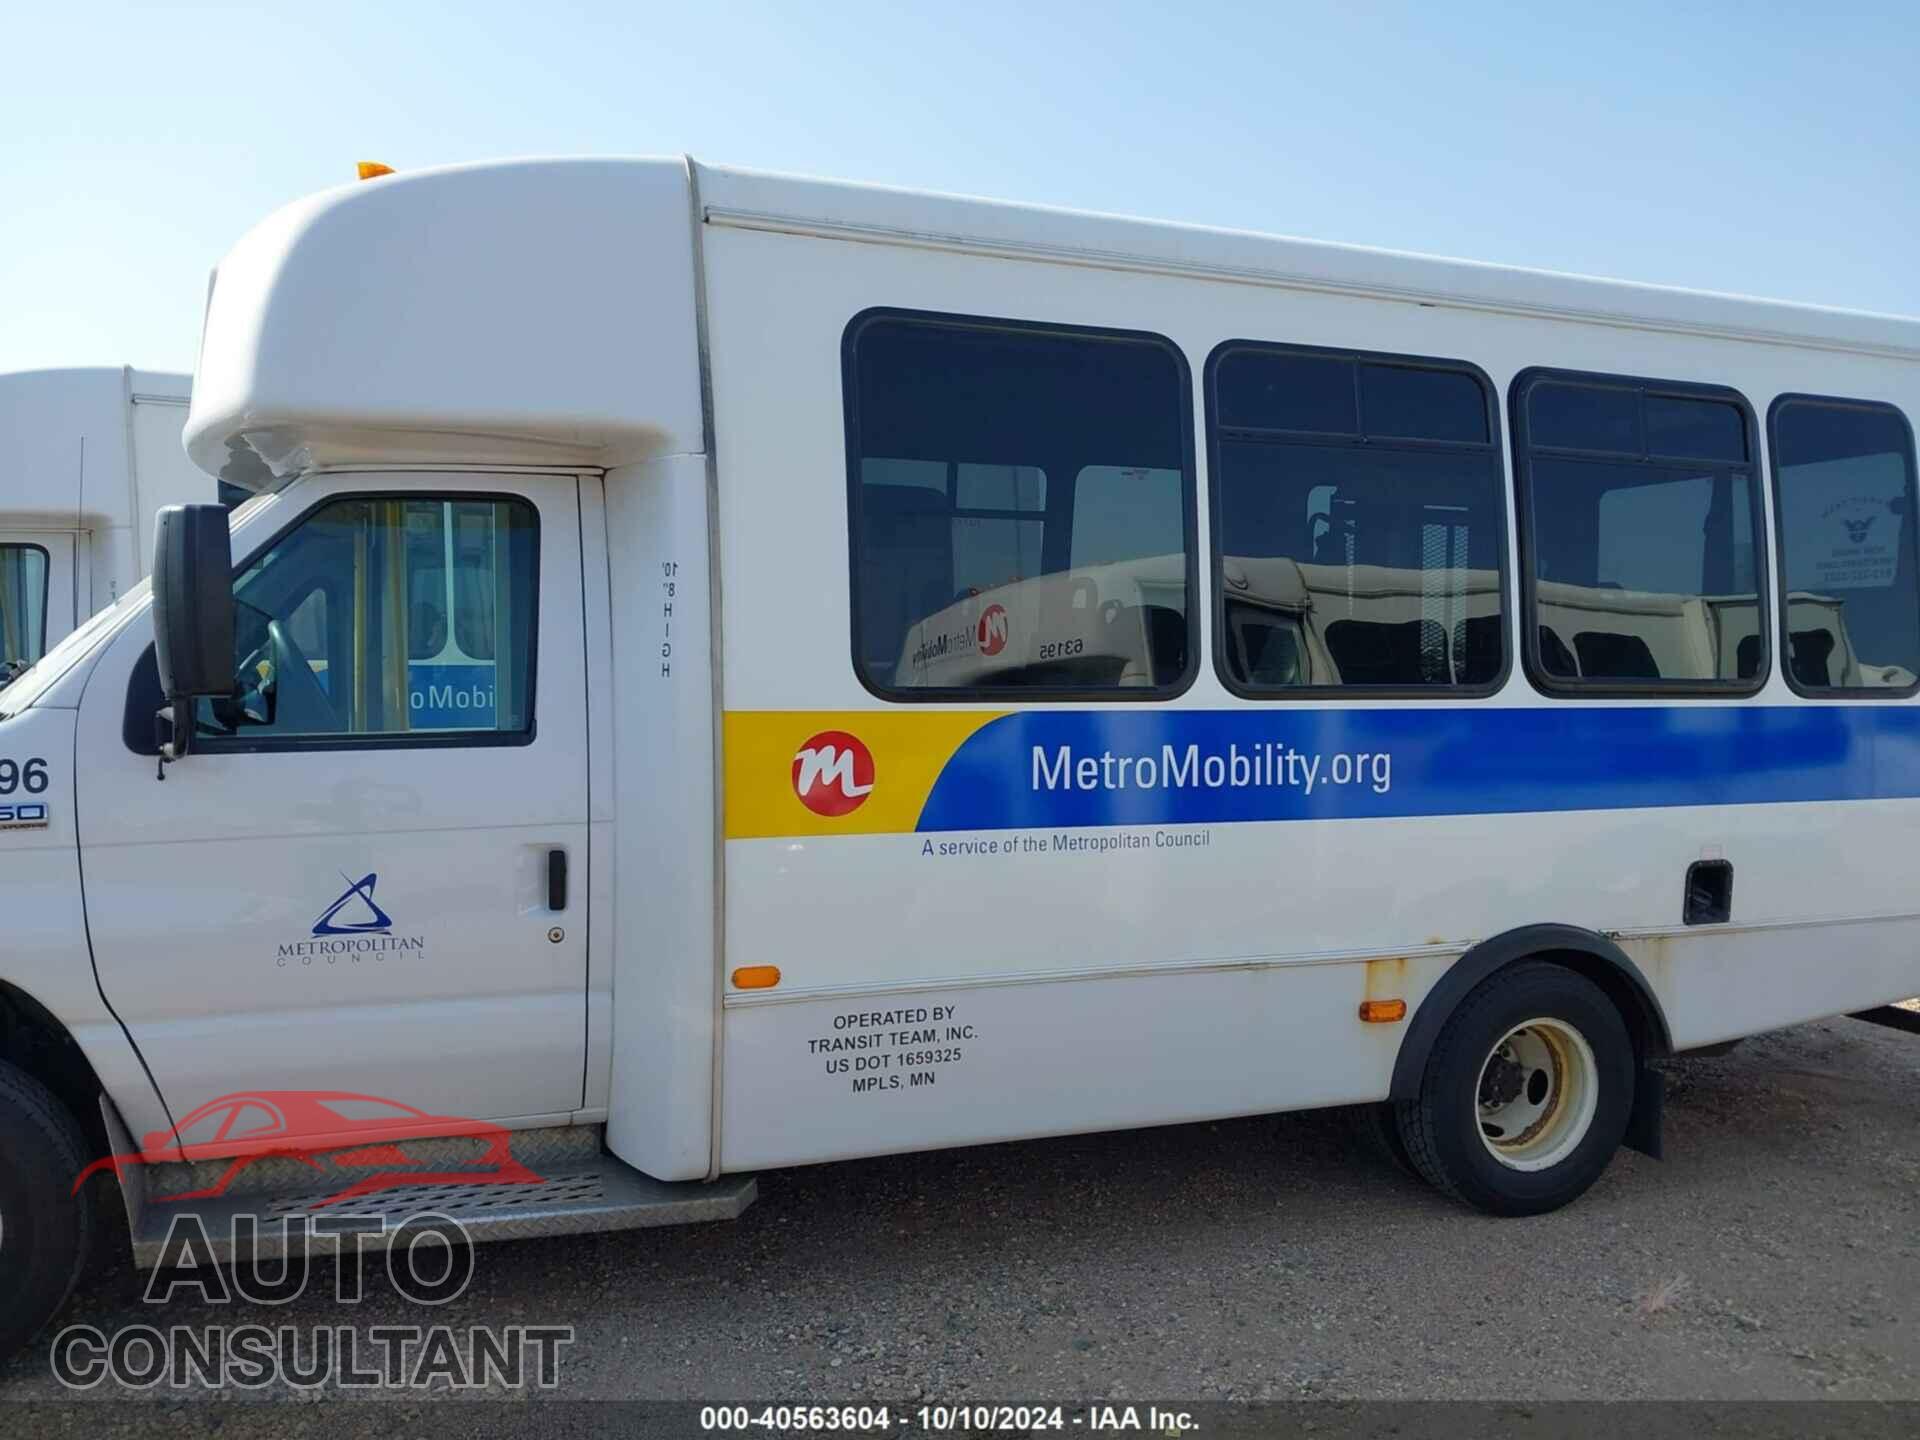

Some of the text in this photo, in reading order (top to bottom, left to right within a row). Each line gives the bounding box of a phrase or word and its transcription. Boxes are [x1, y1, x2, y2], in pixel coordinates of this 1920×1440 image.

[0, 757, 49, 795] 96
[1031, 743, 1392, 795] MetroMobility.org
[921, 830, 1210, 857] A service of the Metropolitan Council
[276, 951, 424, 967] COUNCIL
[277, 936, 424, 957] METROPOLITAN
[833, 1006, 955, 1030] OPERATED BY
[808, 1025, 979, 1054] TRANSIT TEAM, INC.
[826, 1048, 962, 1074] US DOT 1659325
[852, 1072, 935, 1093] MPLS, MN
